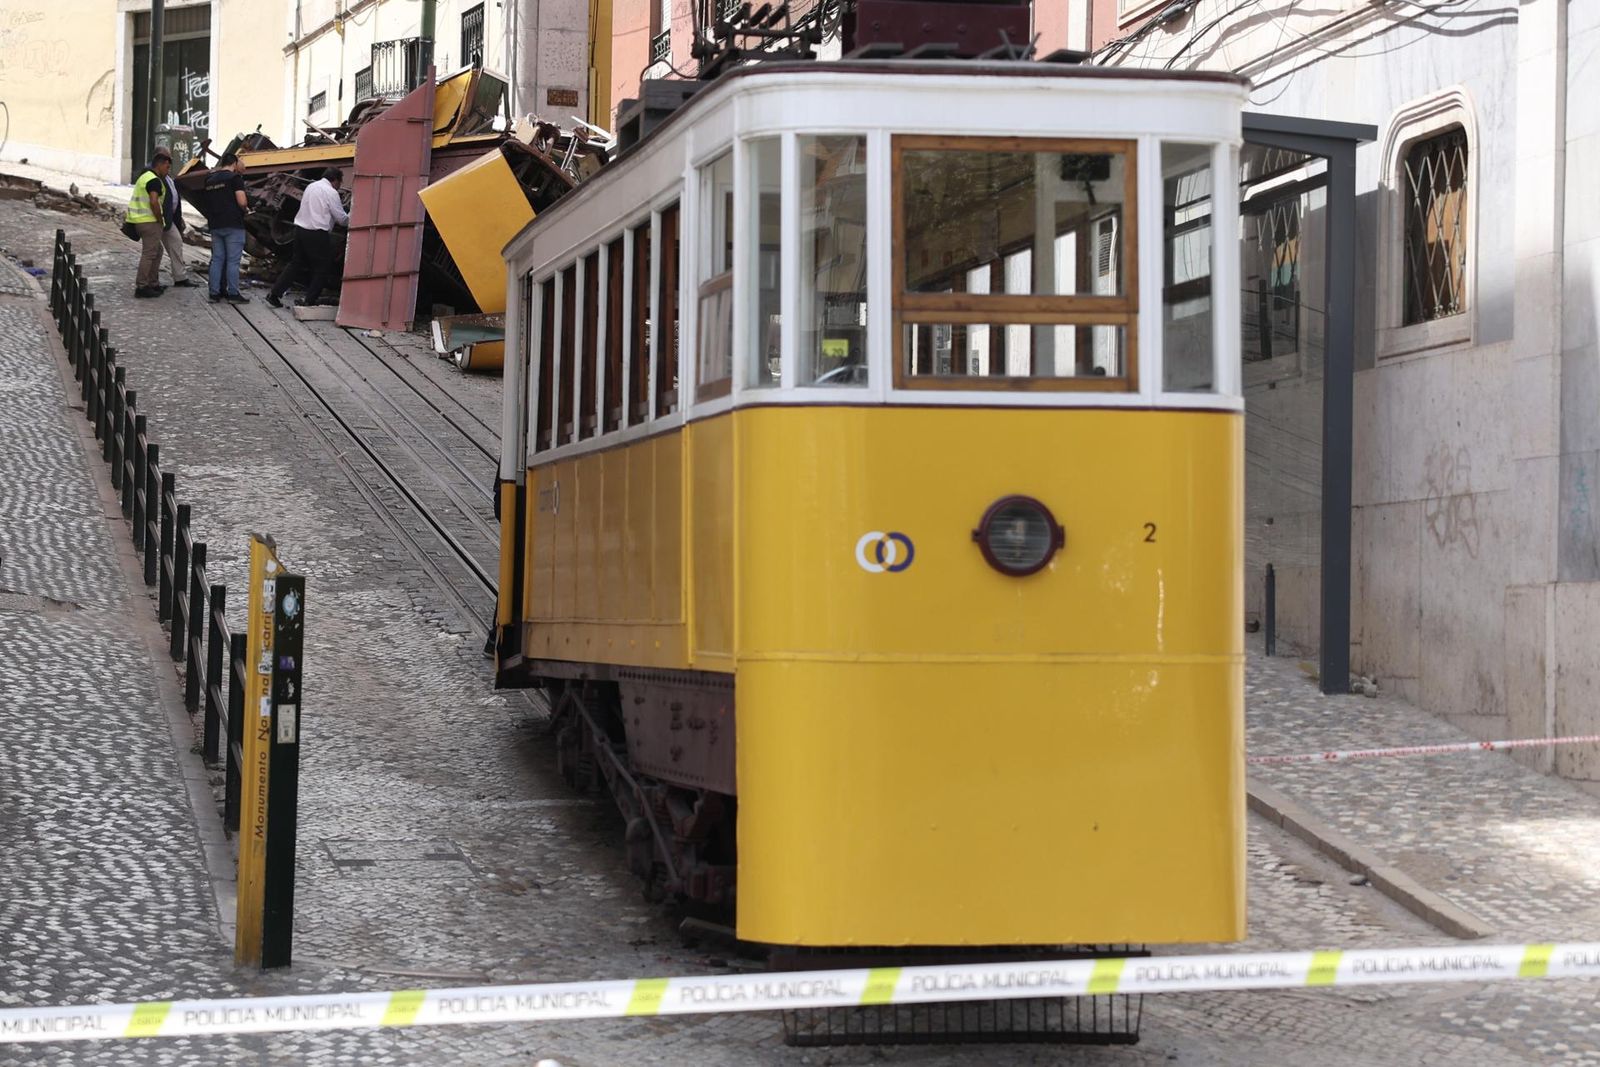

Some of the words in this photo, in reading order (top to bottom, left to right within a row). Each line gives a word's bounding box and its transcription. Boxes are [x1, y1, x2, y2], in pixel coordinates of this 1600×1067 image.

[1143, 522, 1157, 543] 2
[257, 673, 270, 741] Nanal
[255, 751, 268, 839] Monumento
[1, 1015, 107, 1033] MUNICIPAL
[265, 1002, 366, 1022] MUNICIPAL
[516, 990, 611, 1011] MUNICIPAL
[754, 979, 847, 999] MUNICIPAL
[982, 968, 1073, 989] MUNICIPAL
